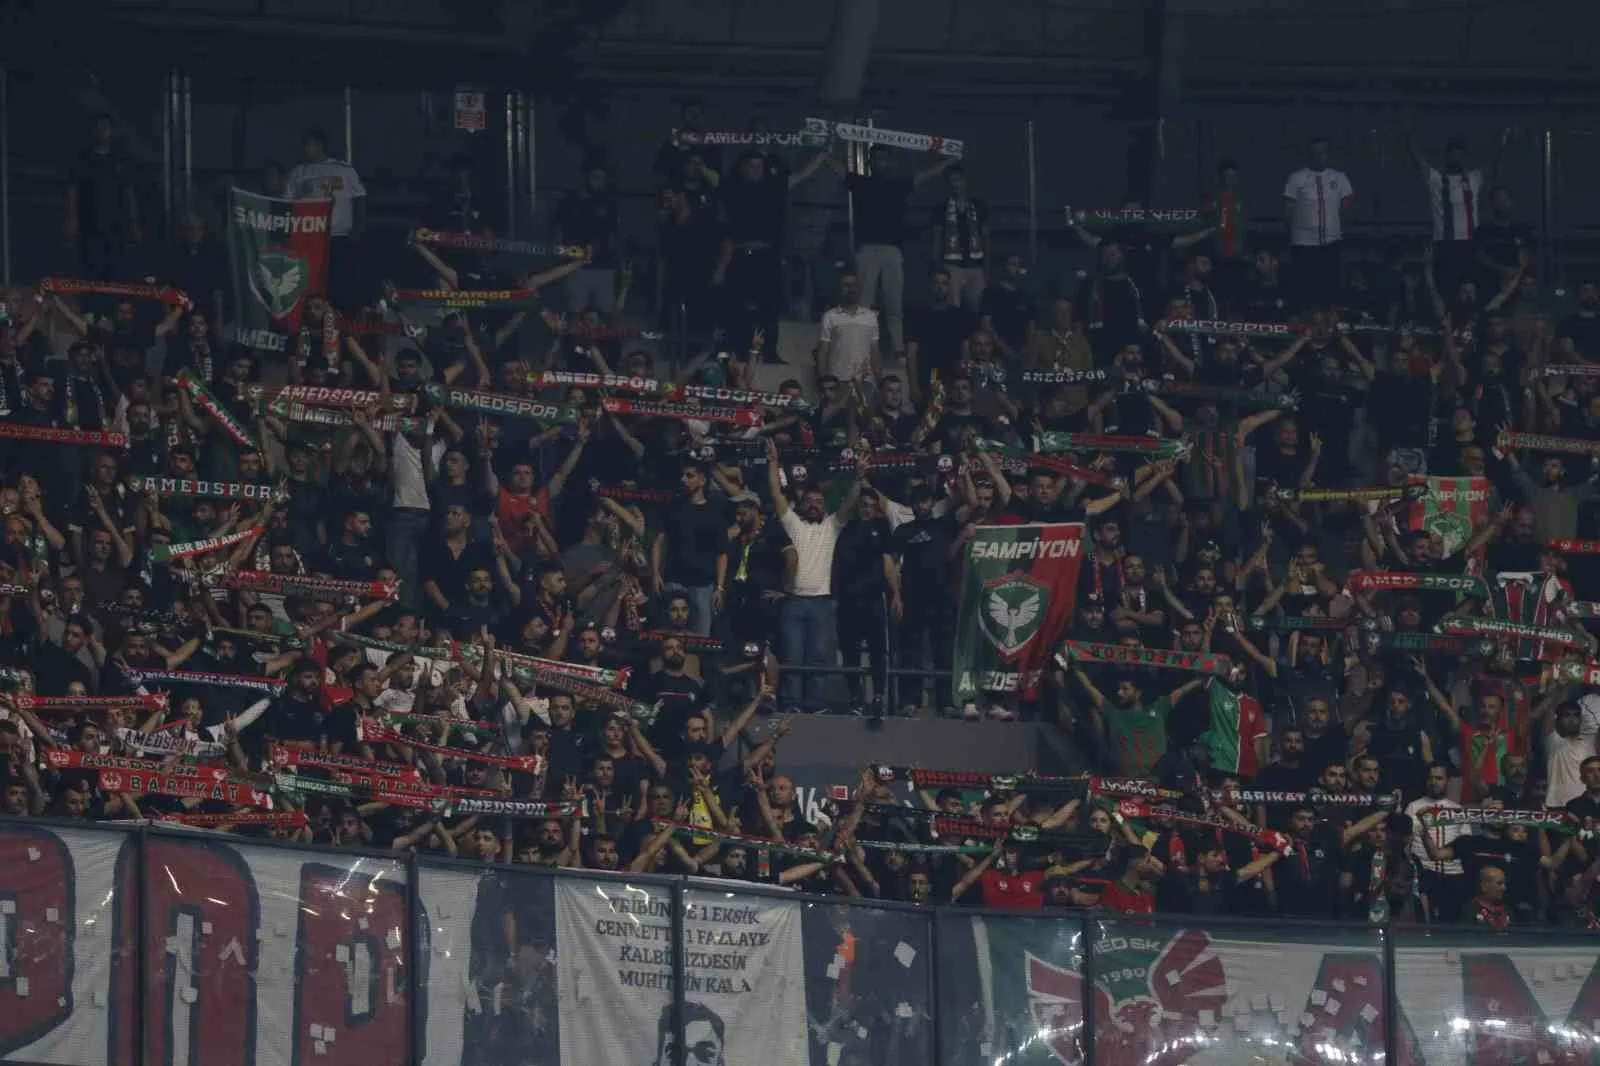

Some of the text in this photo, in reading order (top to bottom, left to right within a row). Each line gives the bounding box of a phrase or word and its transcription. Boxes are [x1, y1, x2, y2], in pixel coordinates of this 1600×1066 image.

[450, 390, 559, 419] AMEDSPOR
[145, 477, 271, 499] AMEDSPOR
[458, 799, 546, 815] AMEDSPOR
[596, 919, 674, 942] CENNETT
